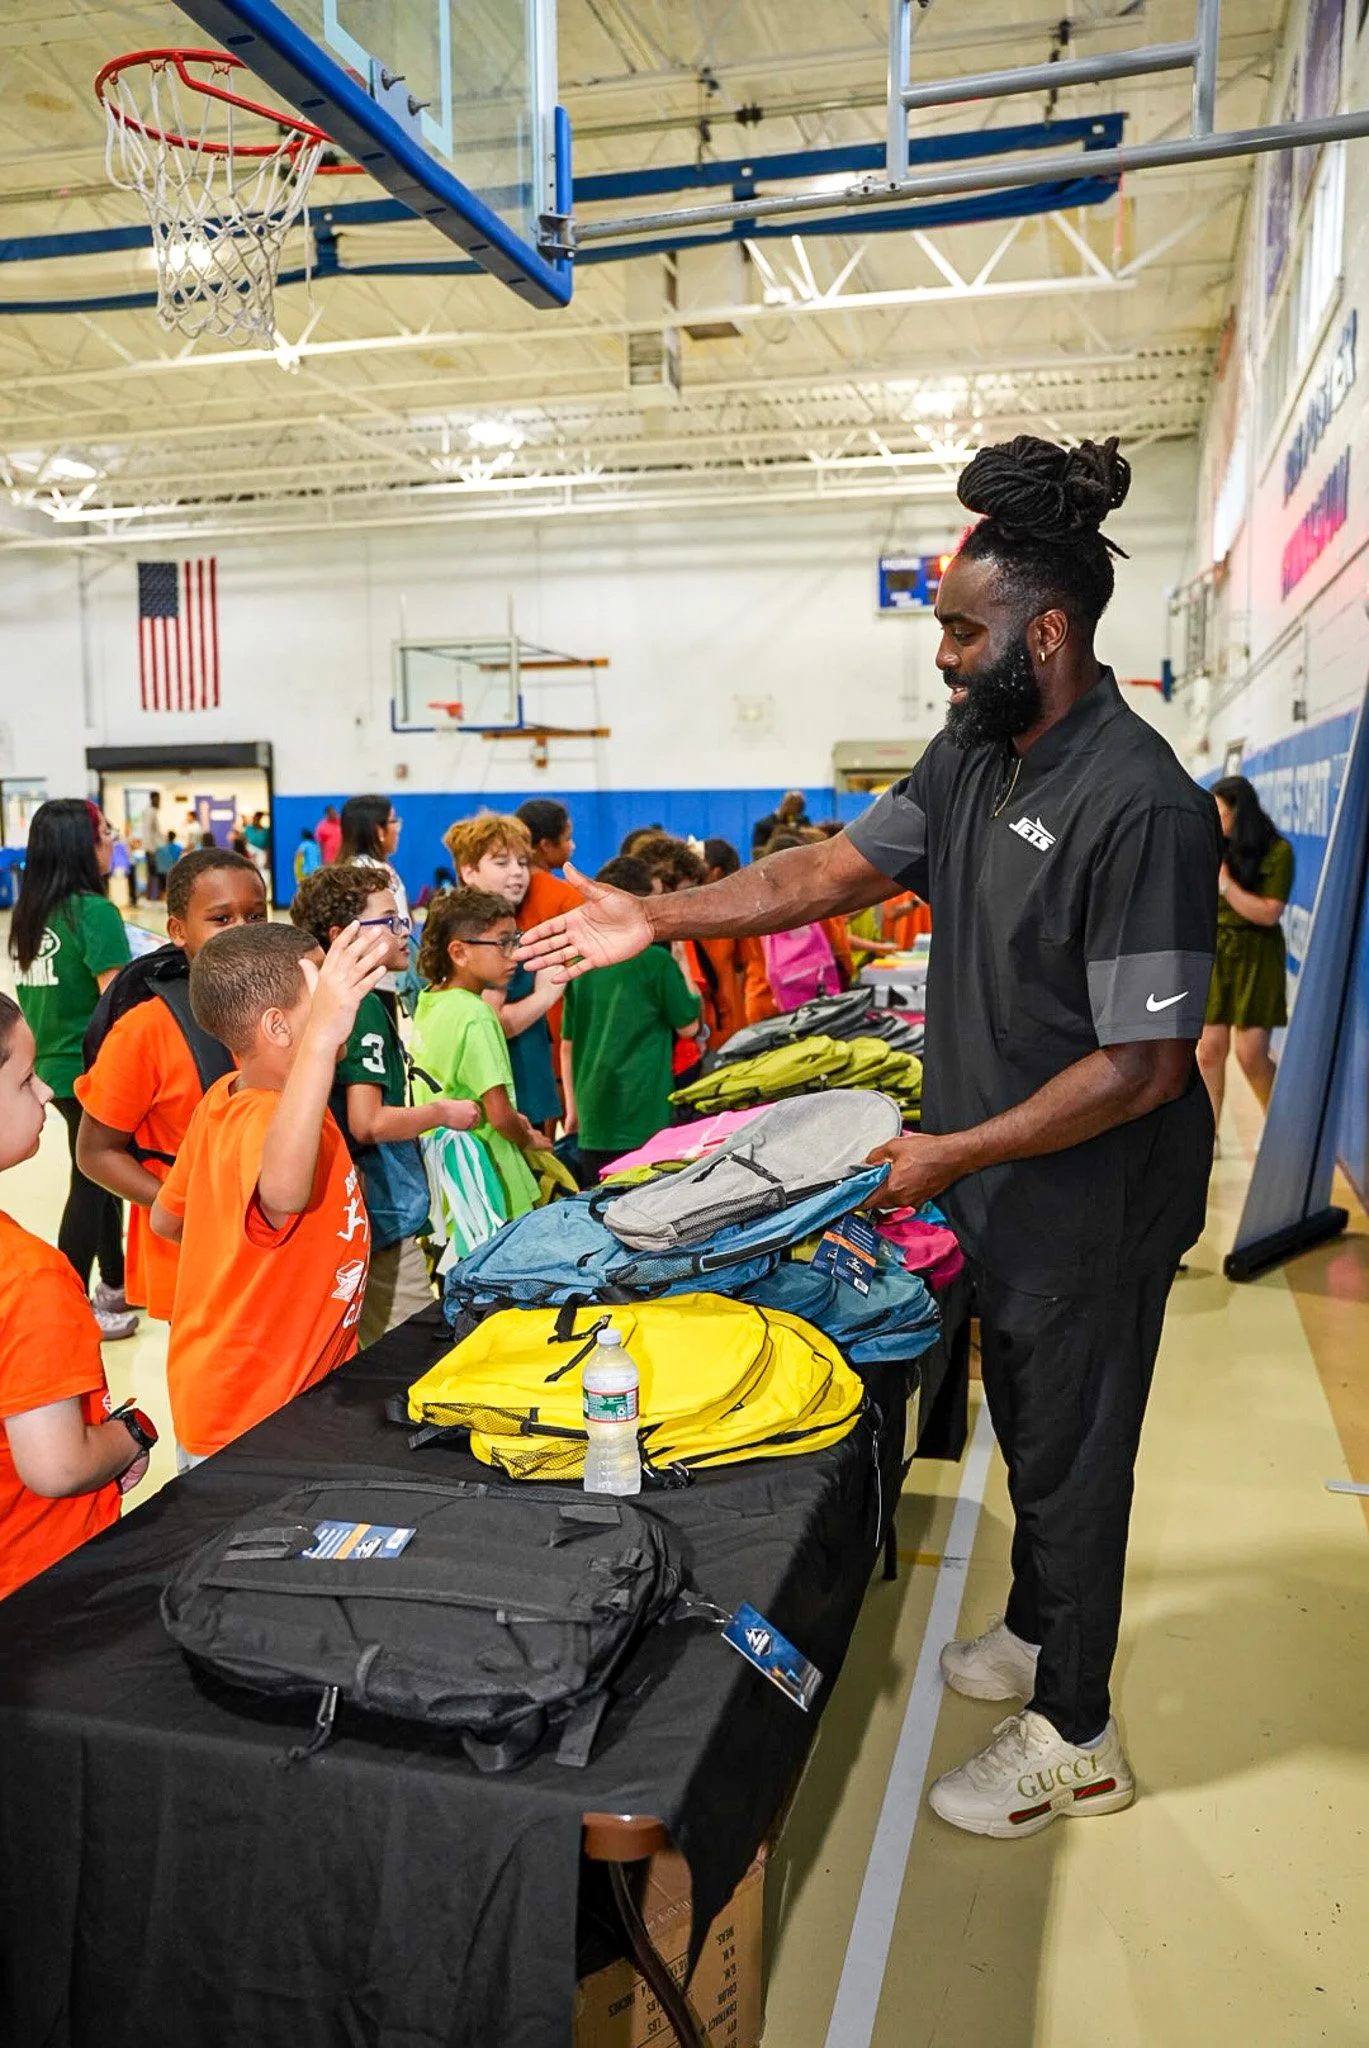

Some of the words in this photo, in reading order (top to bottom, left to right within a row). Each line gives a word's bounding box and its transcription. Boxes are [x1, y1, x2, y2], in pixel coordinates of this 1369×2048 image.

[1008, 816, 1057, 852] JETS
[360, 1032, 387, 1075] 3
[1017, 1755, 1099, 1797] GUCCI
